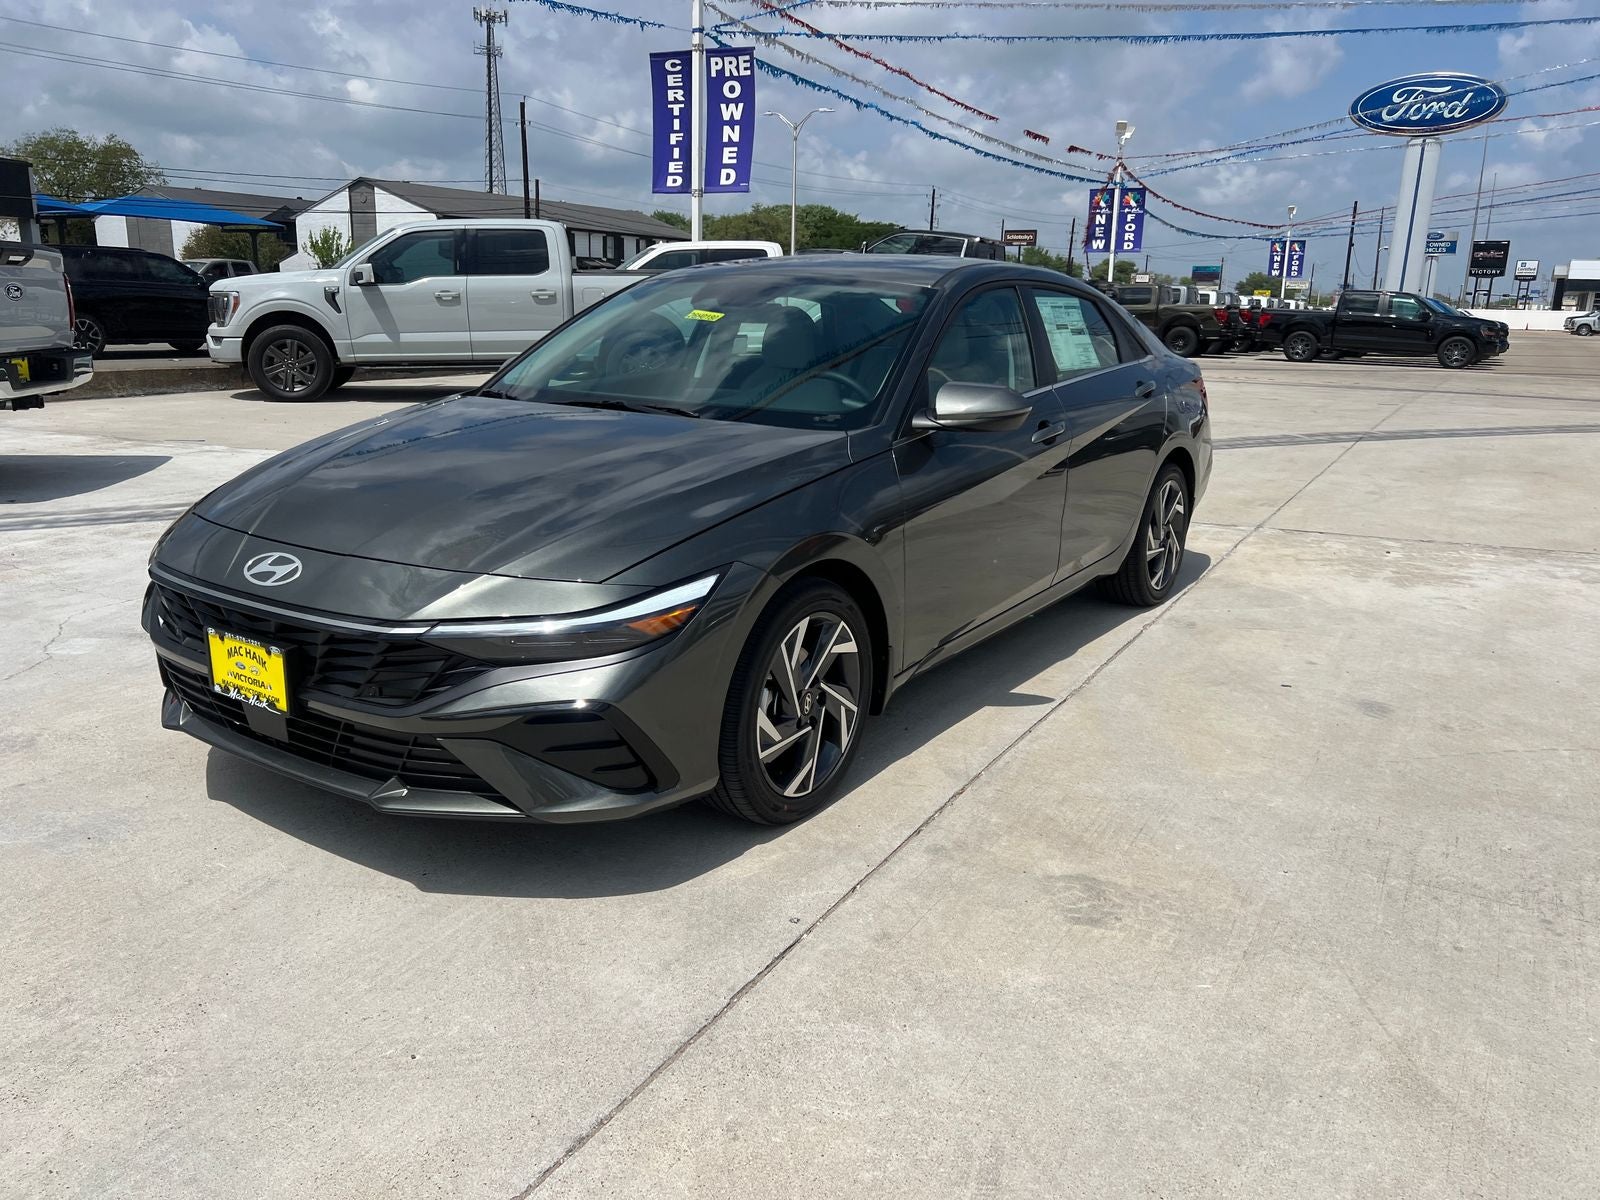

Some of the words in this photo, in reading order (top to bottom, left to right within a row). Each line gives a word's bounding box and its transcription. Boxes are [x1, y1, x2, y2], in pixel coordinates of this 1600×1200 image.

[710, 55, 751, 77] PRE
[1381, 86, 1474, 121] Ford
[664, 59, 685, 187] CERTIFIED
[719, 80, 744, 185] OWNED
[1091, 214, 1106, 250] NEW
[1123, 214, 1136, 250] FORD
[1271, 255, 1280, 276] NEW
[1291, 254, 1300, 276] FORD
[227, 645, 243, 659] MAC
[245, 647, 268, 672] HAIK
[232, 671, 267, 690] VICTORIA
[229, 687, 247, 702] Mac
[248, 695, 272, 709] Haik
